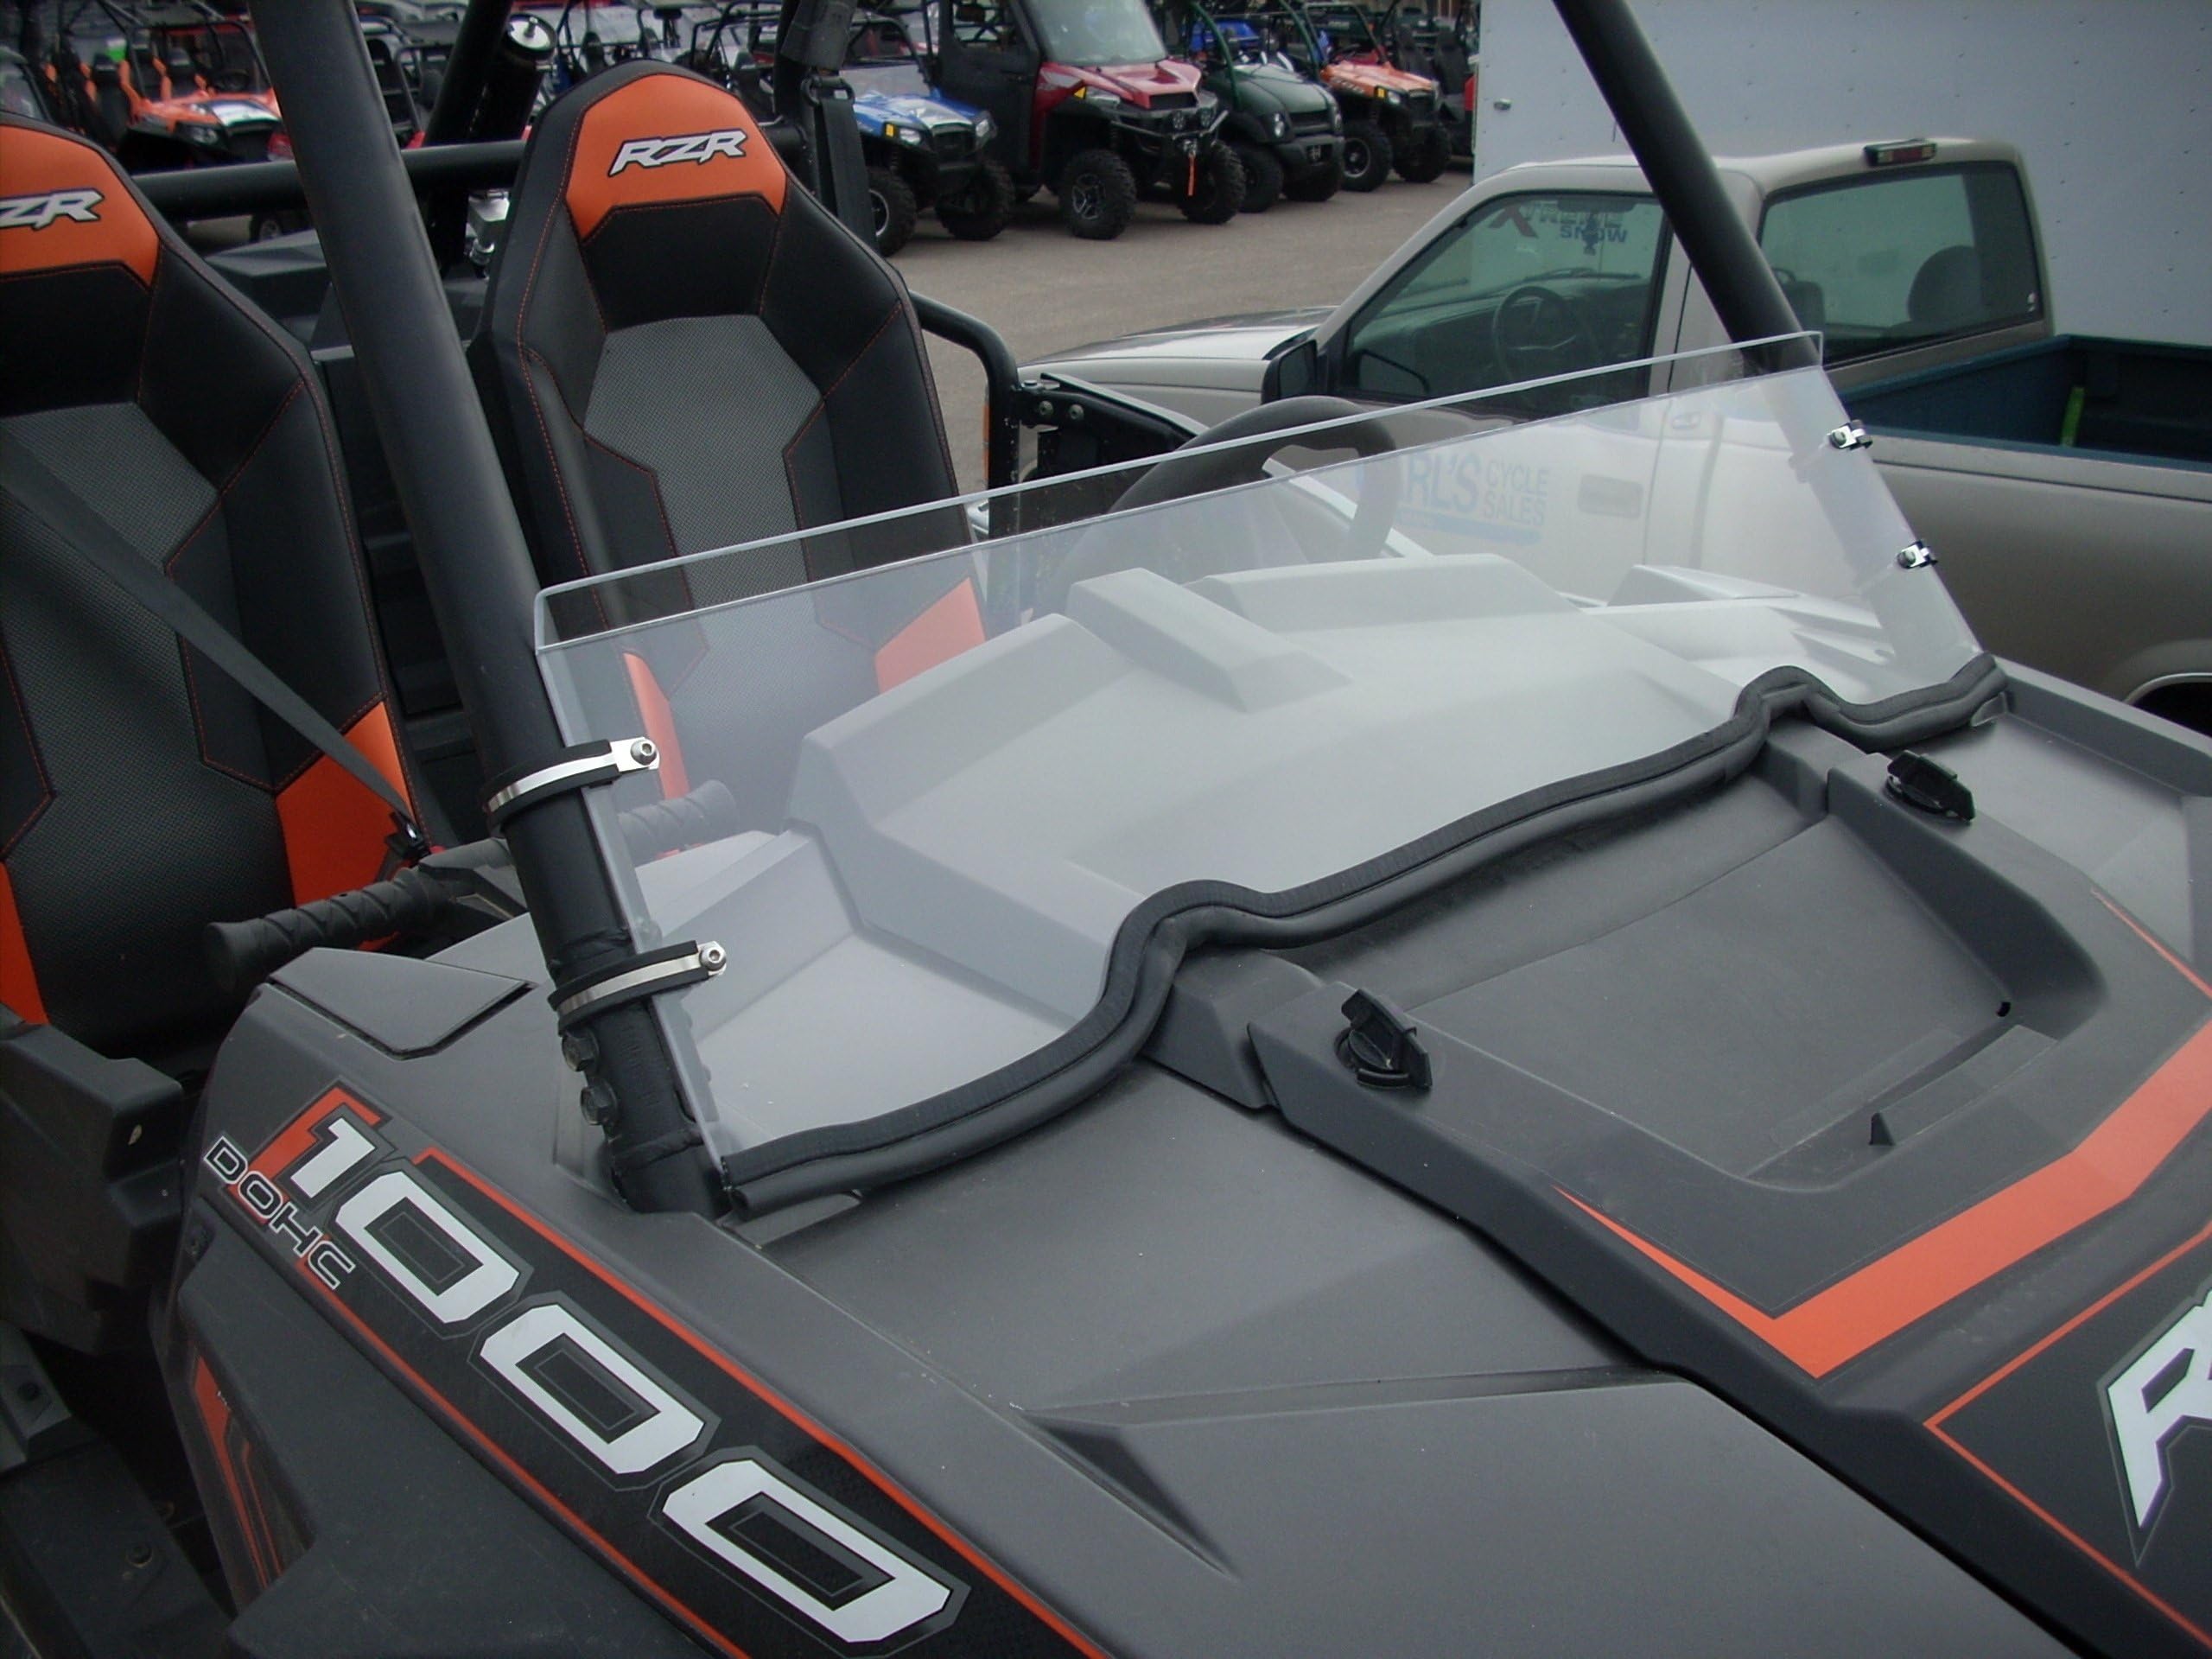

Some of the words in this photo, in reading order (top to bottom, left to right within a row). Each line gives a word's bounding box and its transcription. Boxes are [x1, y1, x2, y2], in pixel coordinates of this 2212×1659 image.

[607, 129, 749, 178] RZR
[1394, 451, 1481, 514] RL'S
[1483, 490, 1547, 528] SALES
[1486, 460, 1549, 498] CYCLE
[204, 1135, 356, 1290] DOHC
[289, 1117, 950, 1644] 1000
[2107, 1289, 2212, 1529] R
